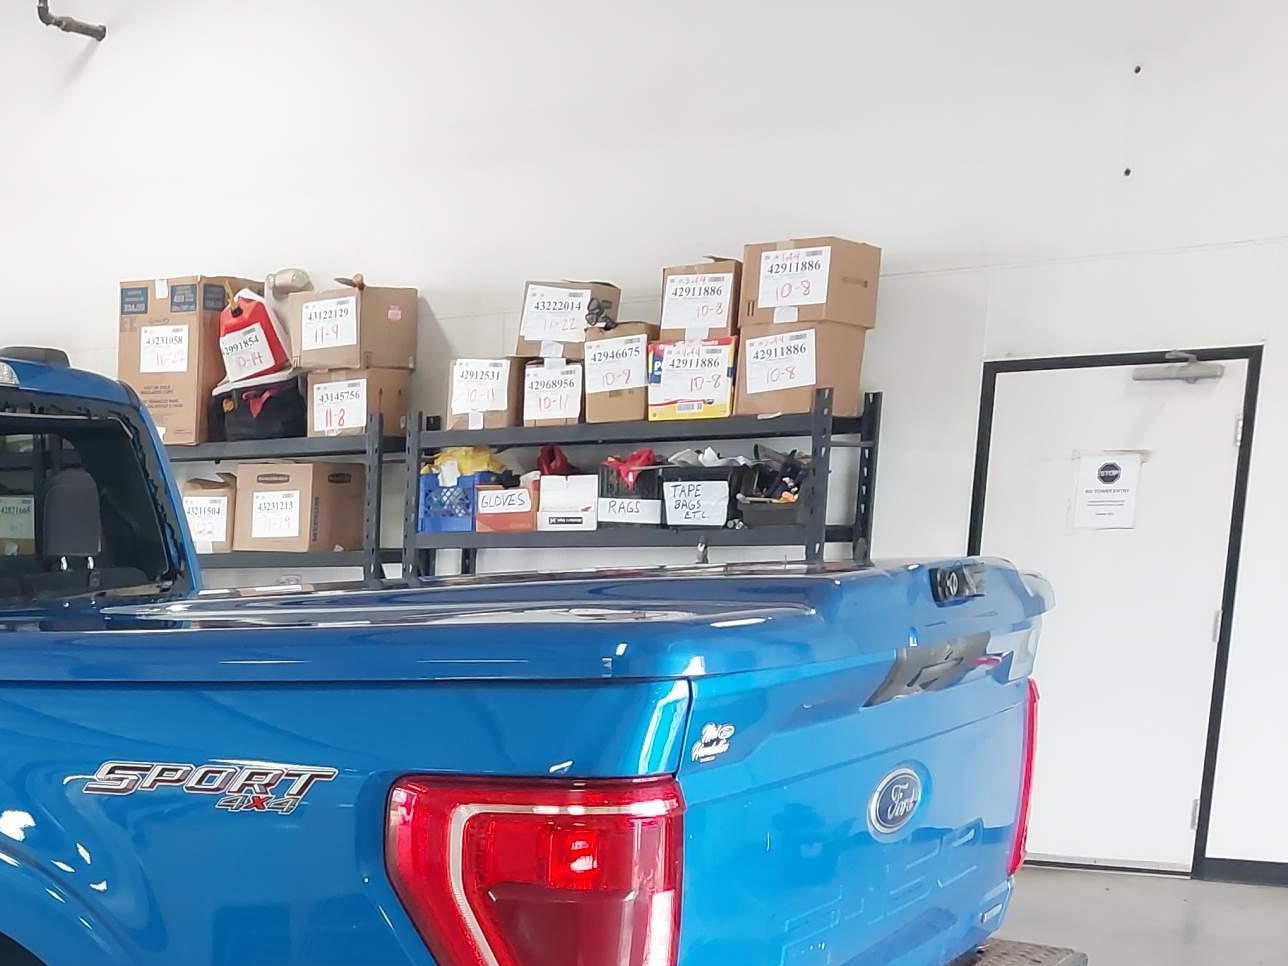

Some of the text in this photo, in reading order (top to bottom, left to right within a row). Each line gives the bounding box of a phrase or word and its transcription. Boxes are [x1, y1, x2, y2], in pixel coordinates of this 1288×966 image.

[768, 260, 821, 275] 42911886
[672, 286, 722, 297] 42911886
[776, 280, 811, 300] 10-8
[534, 301, 581, 311] 43222014
[697, 302, 723, 319] 10-8
[308, 308, 349, 321] 43122129
[591, 347, 641, 362] 42946675
[753, 343, 807, 360] 42911886
[669, 358, 720, 369] 42911886
[460, 370, 500, 380] 42912531
[767, 367, 797, 384] 10-8
[528, 378, 575, 391] 42968956
[690, 374, 722, 392] 10-8
[319, 390, 360, 402] 43145756
[671, 484, 702, 498] TAPE
[257, 501, 293, 511] 43231213
[481, 493, 525, 508] GLOVES
[608, 500, 641, 514] RAGS
[674, 499, 701, 510] BAGS
[82, 759, 339, 798] SPORT
[888, 783, 915, 820] Ford
